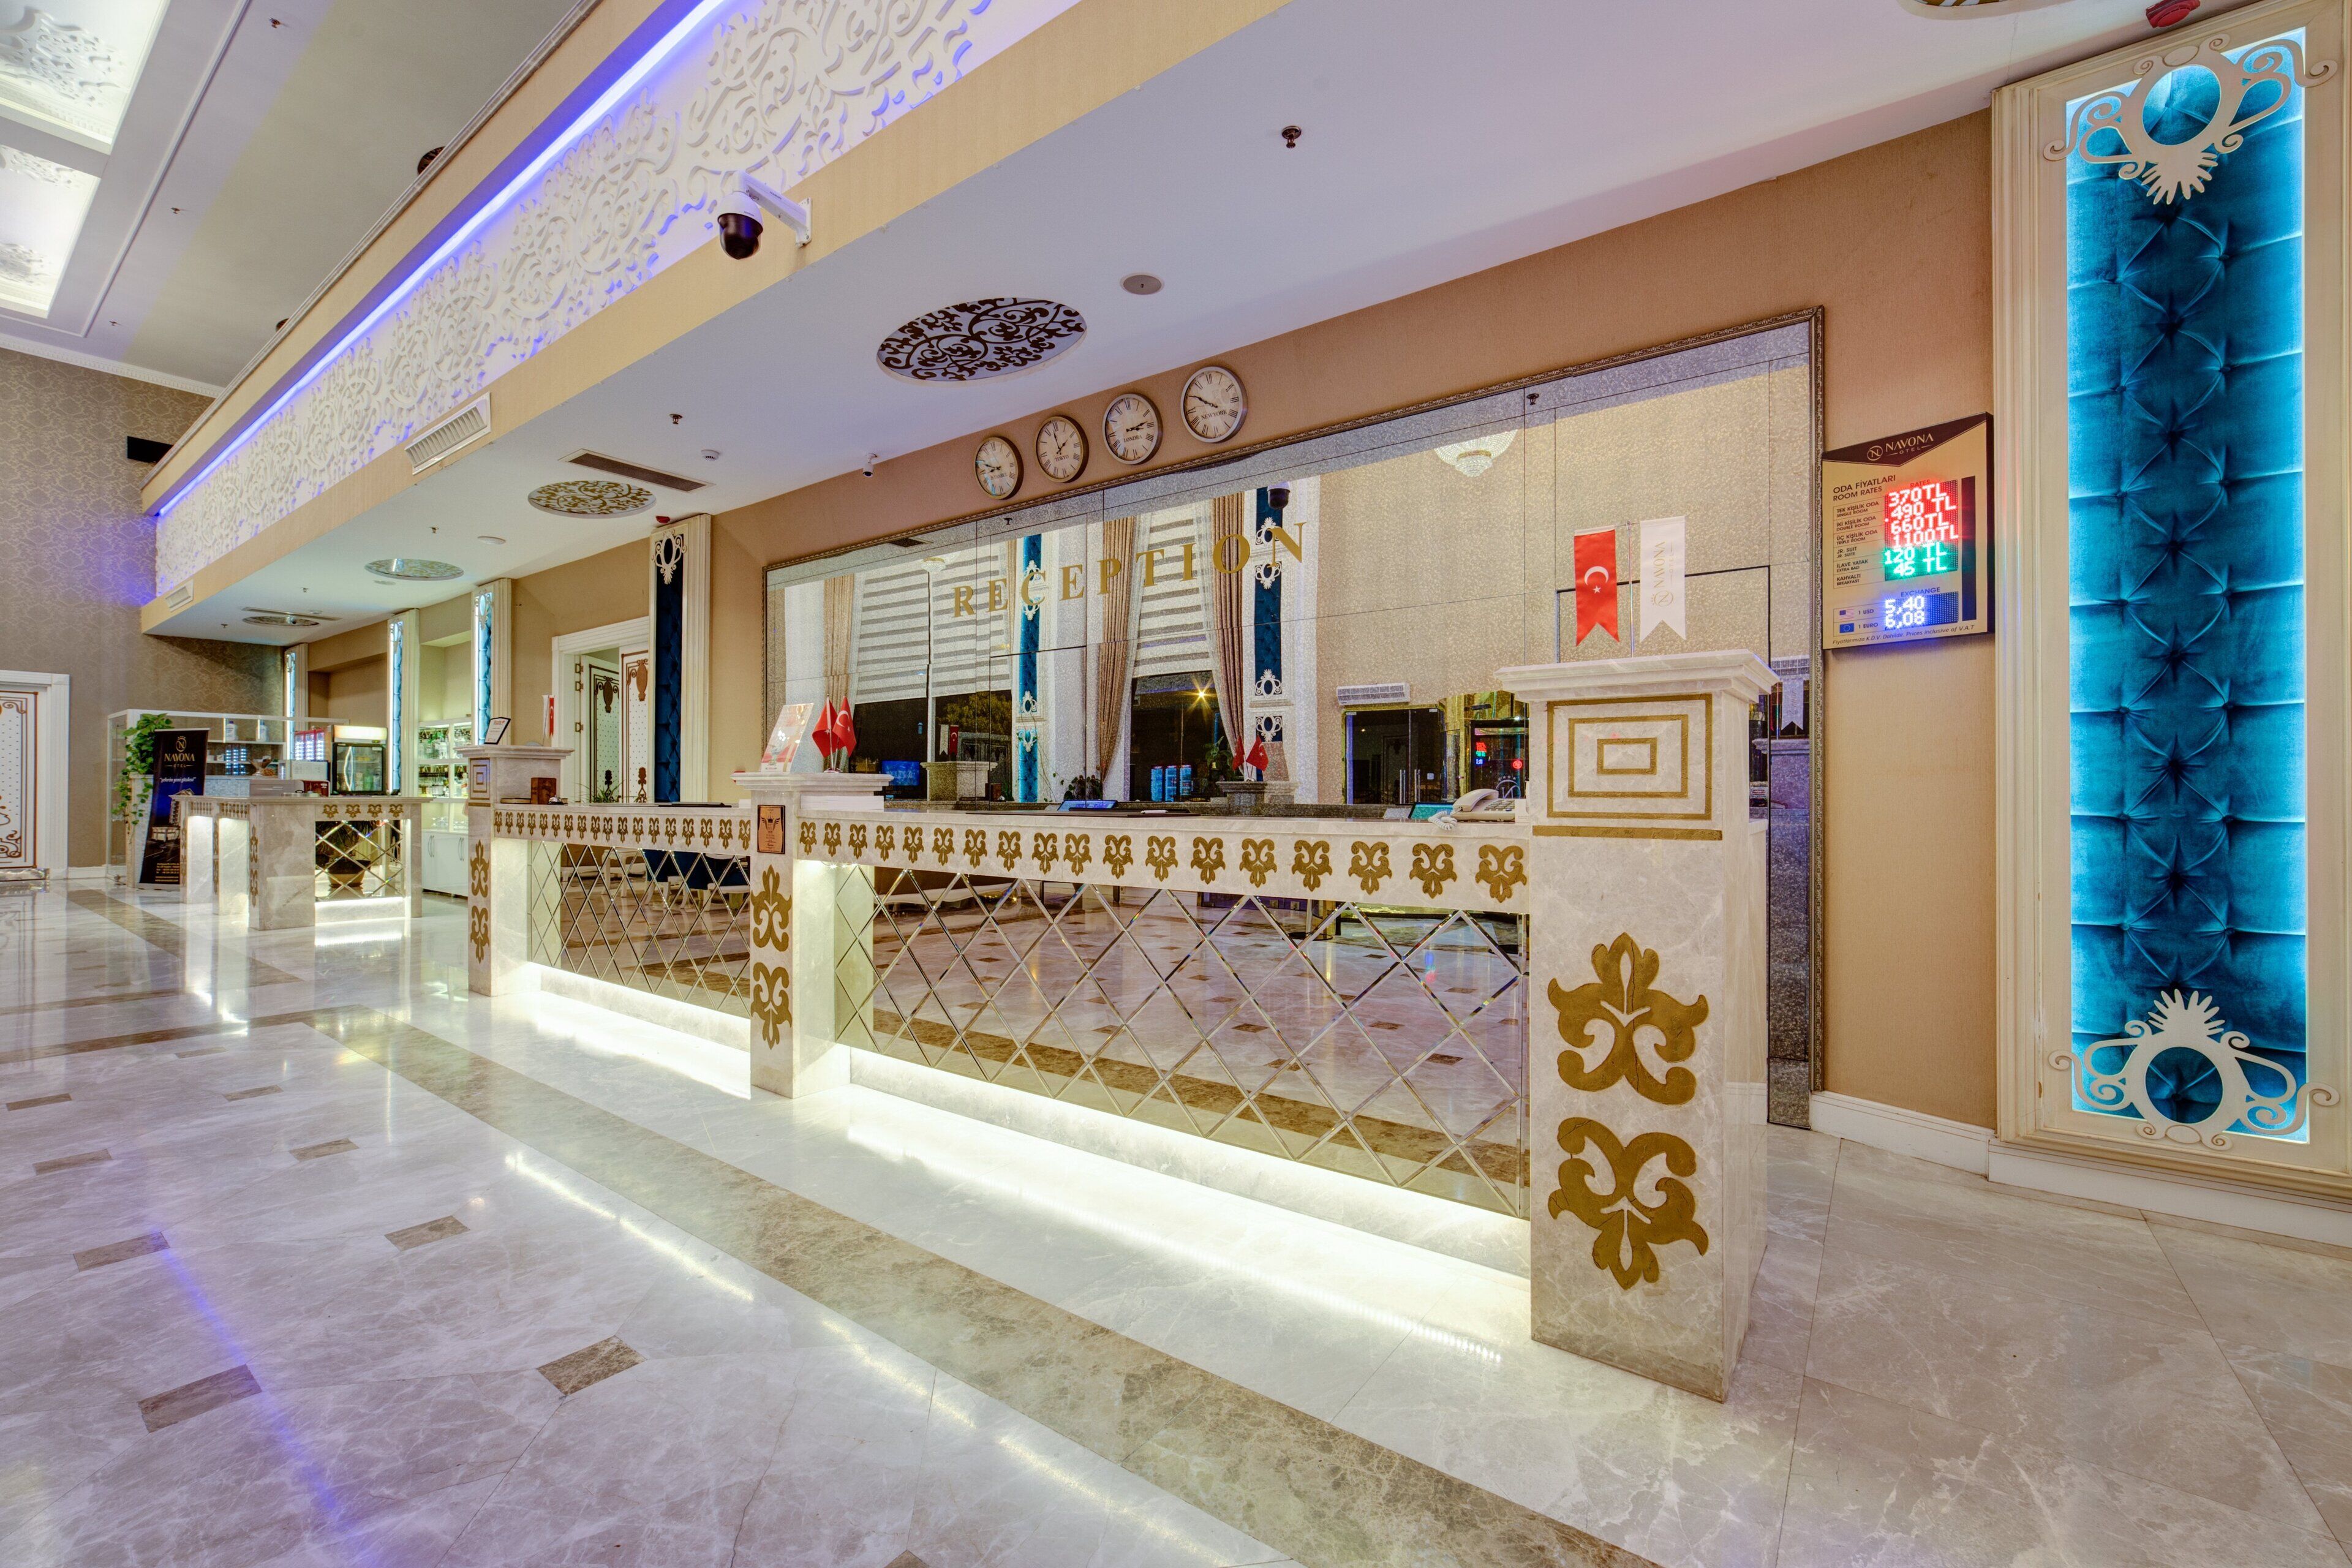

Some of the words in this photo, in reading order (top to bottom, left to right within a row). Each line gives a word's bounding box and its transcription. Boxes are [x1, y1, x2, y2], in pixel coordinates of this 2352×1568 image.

[1885, 433, 1934, 453] NAVONA
[1833, 484, 1853, 494] ODA
[1855, 475, 1896, 489] FİYATLARI
[1833, 491, 1858, 502] ROOM
[1860, 486, 1882, 496] RATES
[1931, 496, 1957, 512] TL
[1922, 541, 1948, 558] TL
[952, 522, 1307, 618] RECEPTION
[1922, 557, 1948, 573] TL
[1901, 587, 1941, 597] EXCHANGE
[1885, 595, 1925, 615] 5,40
[1885, 610, 1925, 629] 6,08
[164, 753, 195, 762] NAVONA
